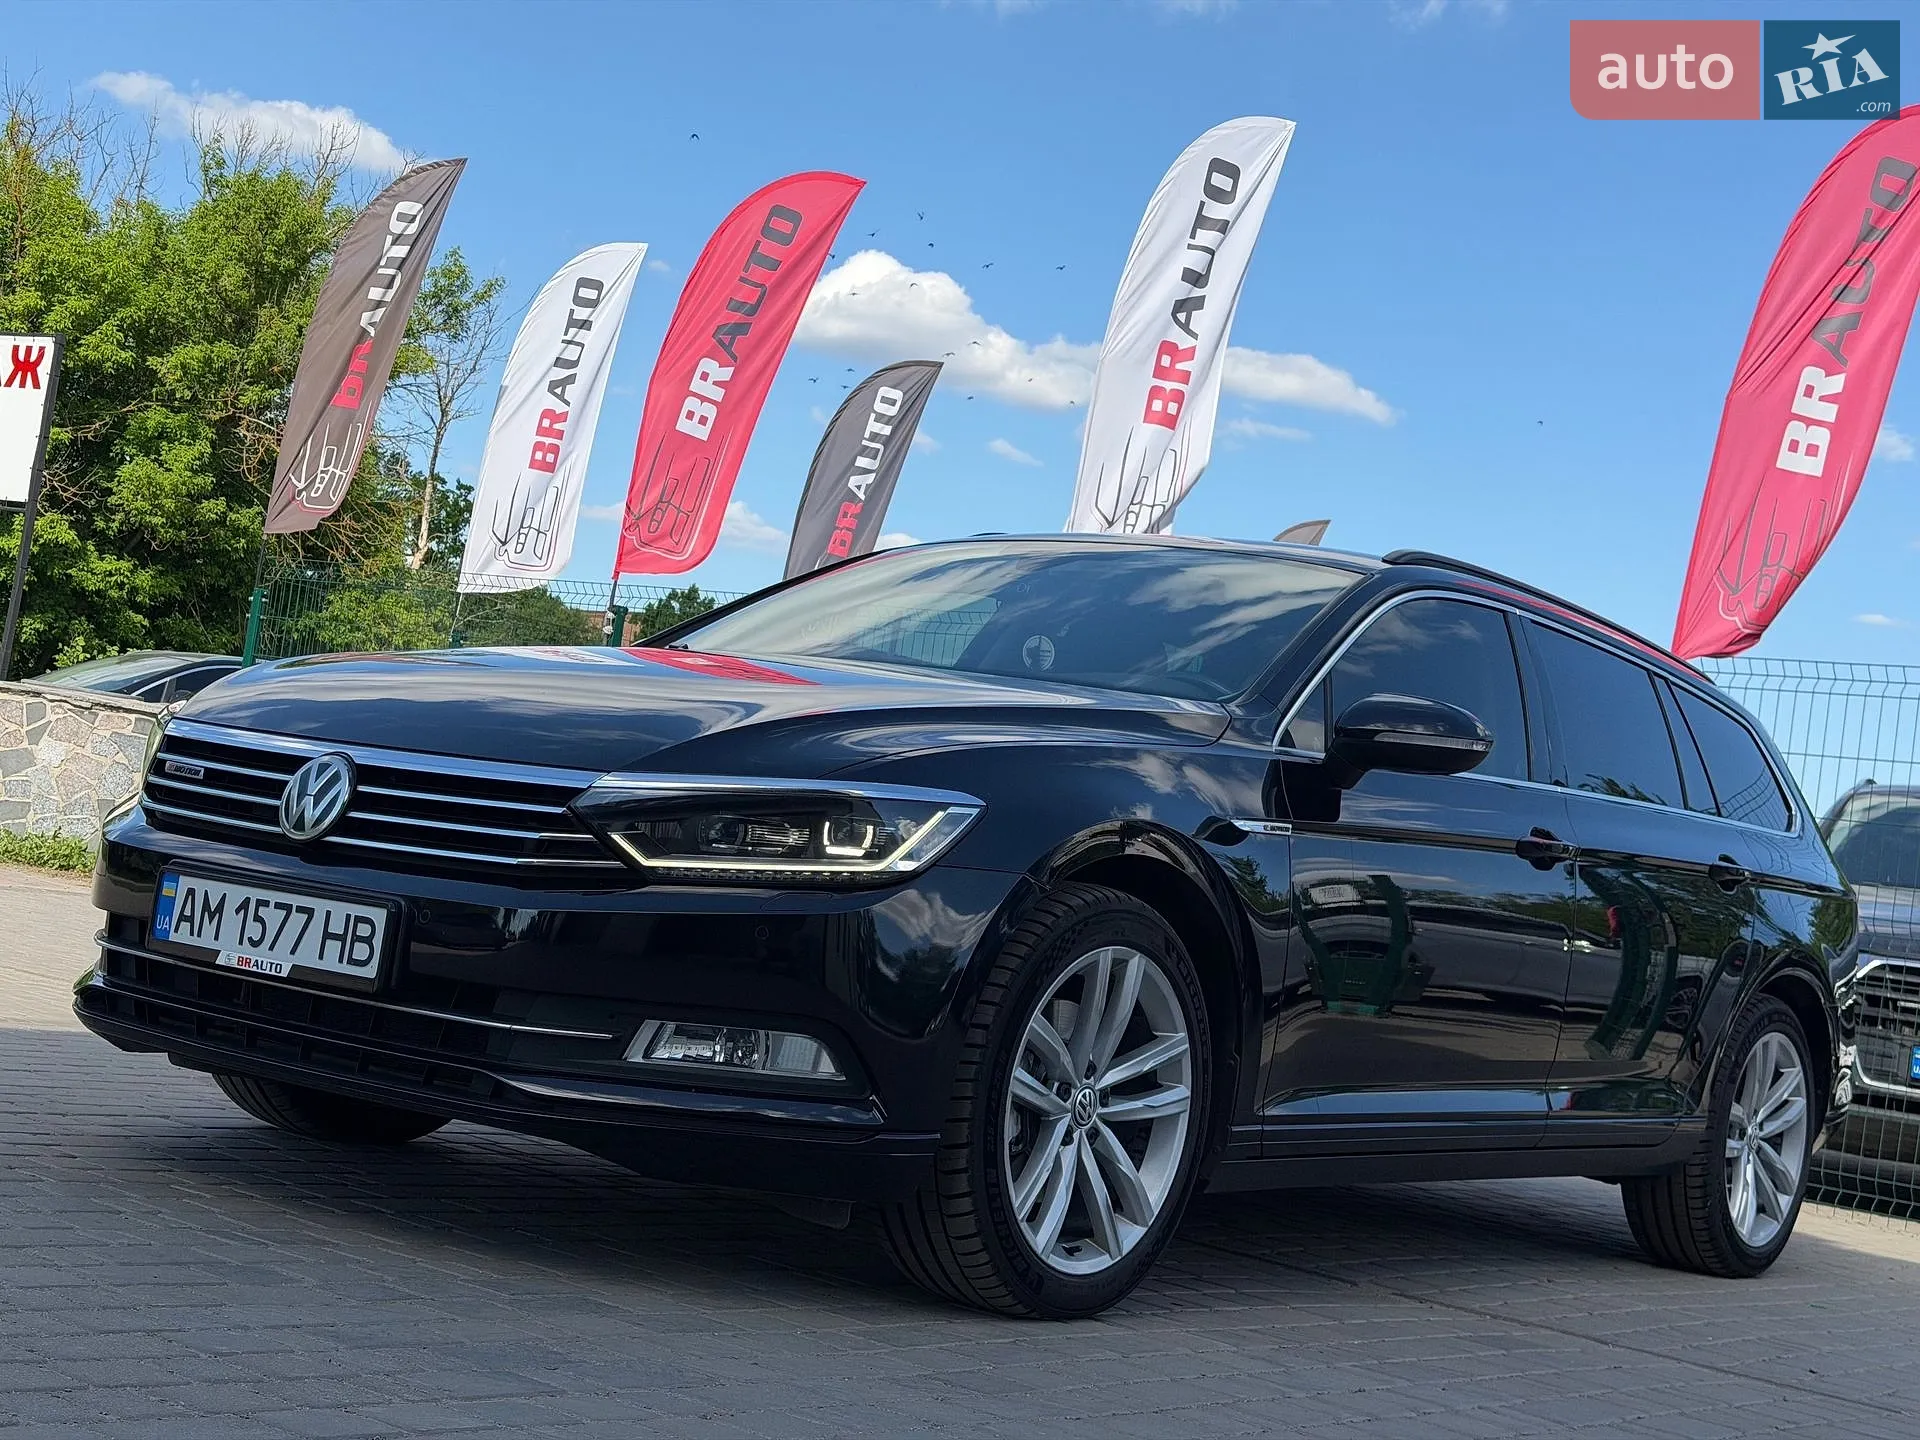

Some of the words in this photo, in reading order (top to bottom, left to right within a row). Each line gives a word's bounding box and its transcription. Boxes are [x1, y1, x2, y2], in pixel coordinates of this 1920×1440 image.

[674, 203, 803, 442] BRAUTO
[1142, 157, 1242, 431] BRAUTO
[0, 344, 46, 390] Ж
[528, 276, 604, 475] BRAUTO
[827, 386, 904, 558] BRAUTO
[156, 914, 170, 932] UA
[173, 887, 227, 942] AM
[234, 896, 315, 956] 1577
[318, 909, 377, 968] HB
[236, 955, 283, 974] BRAUTO
